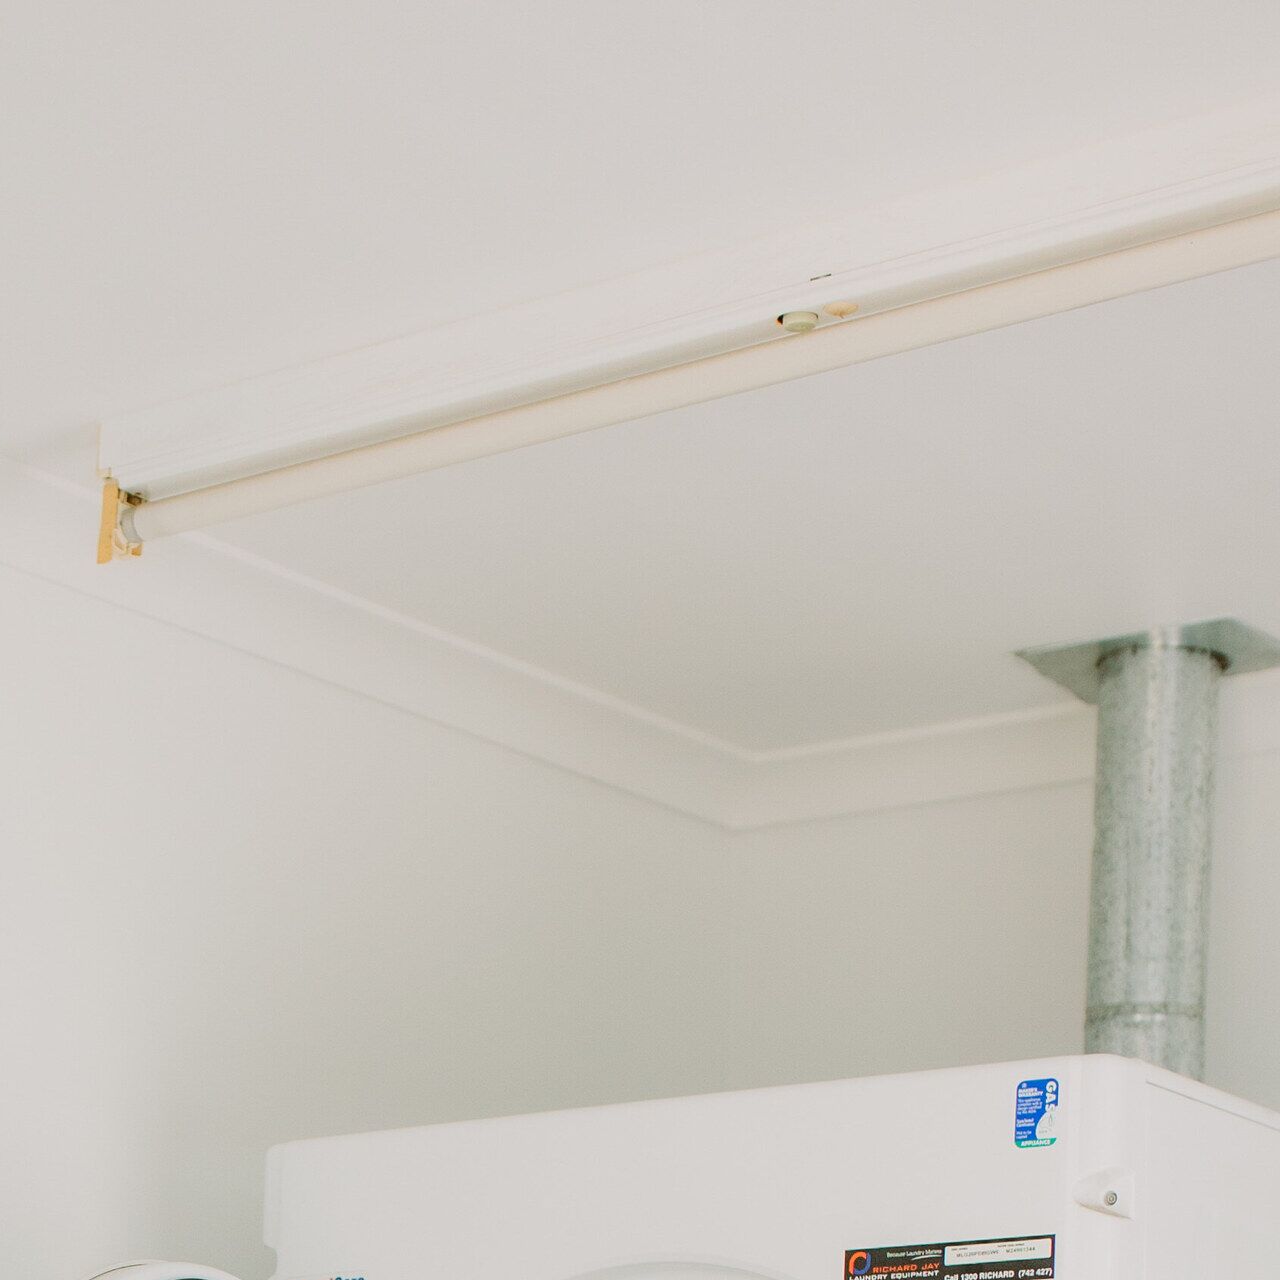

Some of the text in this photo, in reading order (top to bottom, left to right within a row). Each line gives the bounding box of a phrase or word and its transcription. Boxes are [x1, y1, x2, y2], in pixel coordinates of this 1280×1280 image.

[873, 1262, 939, 1274] RICHARD JAY
[960, 1273, 978, 1280] 1300
[979, 1270, 1015, 1280] RICHARD
[1018, 1268, 1035, 1279] (742
[1035, 1267, 1053, 1277] 427)
[891, 1270, 940, 1280] EQUIPMENT
